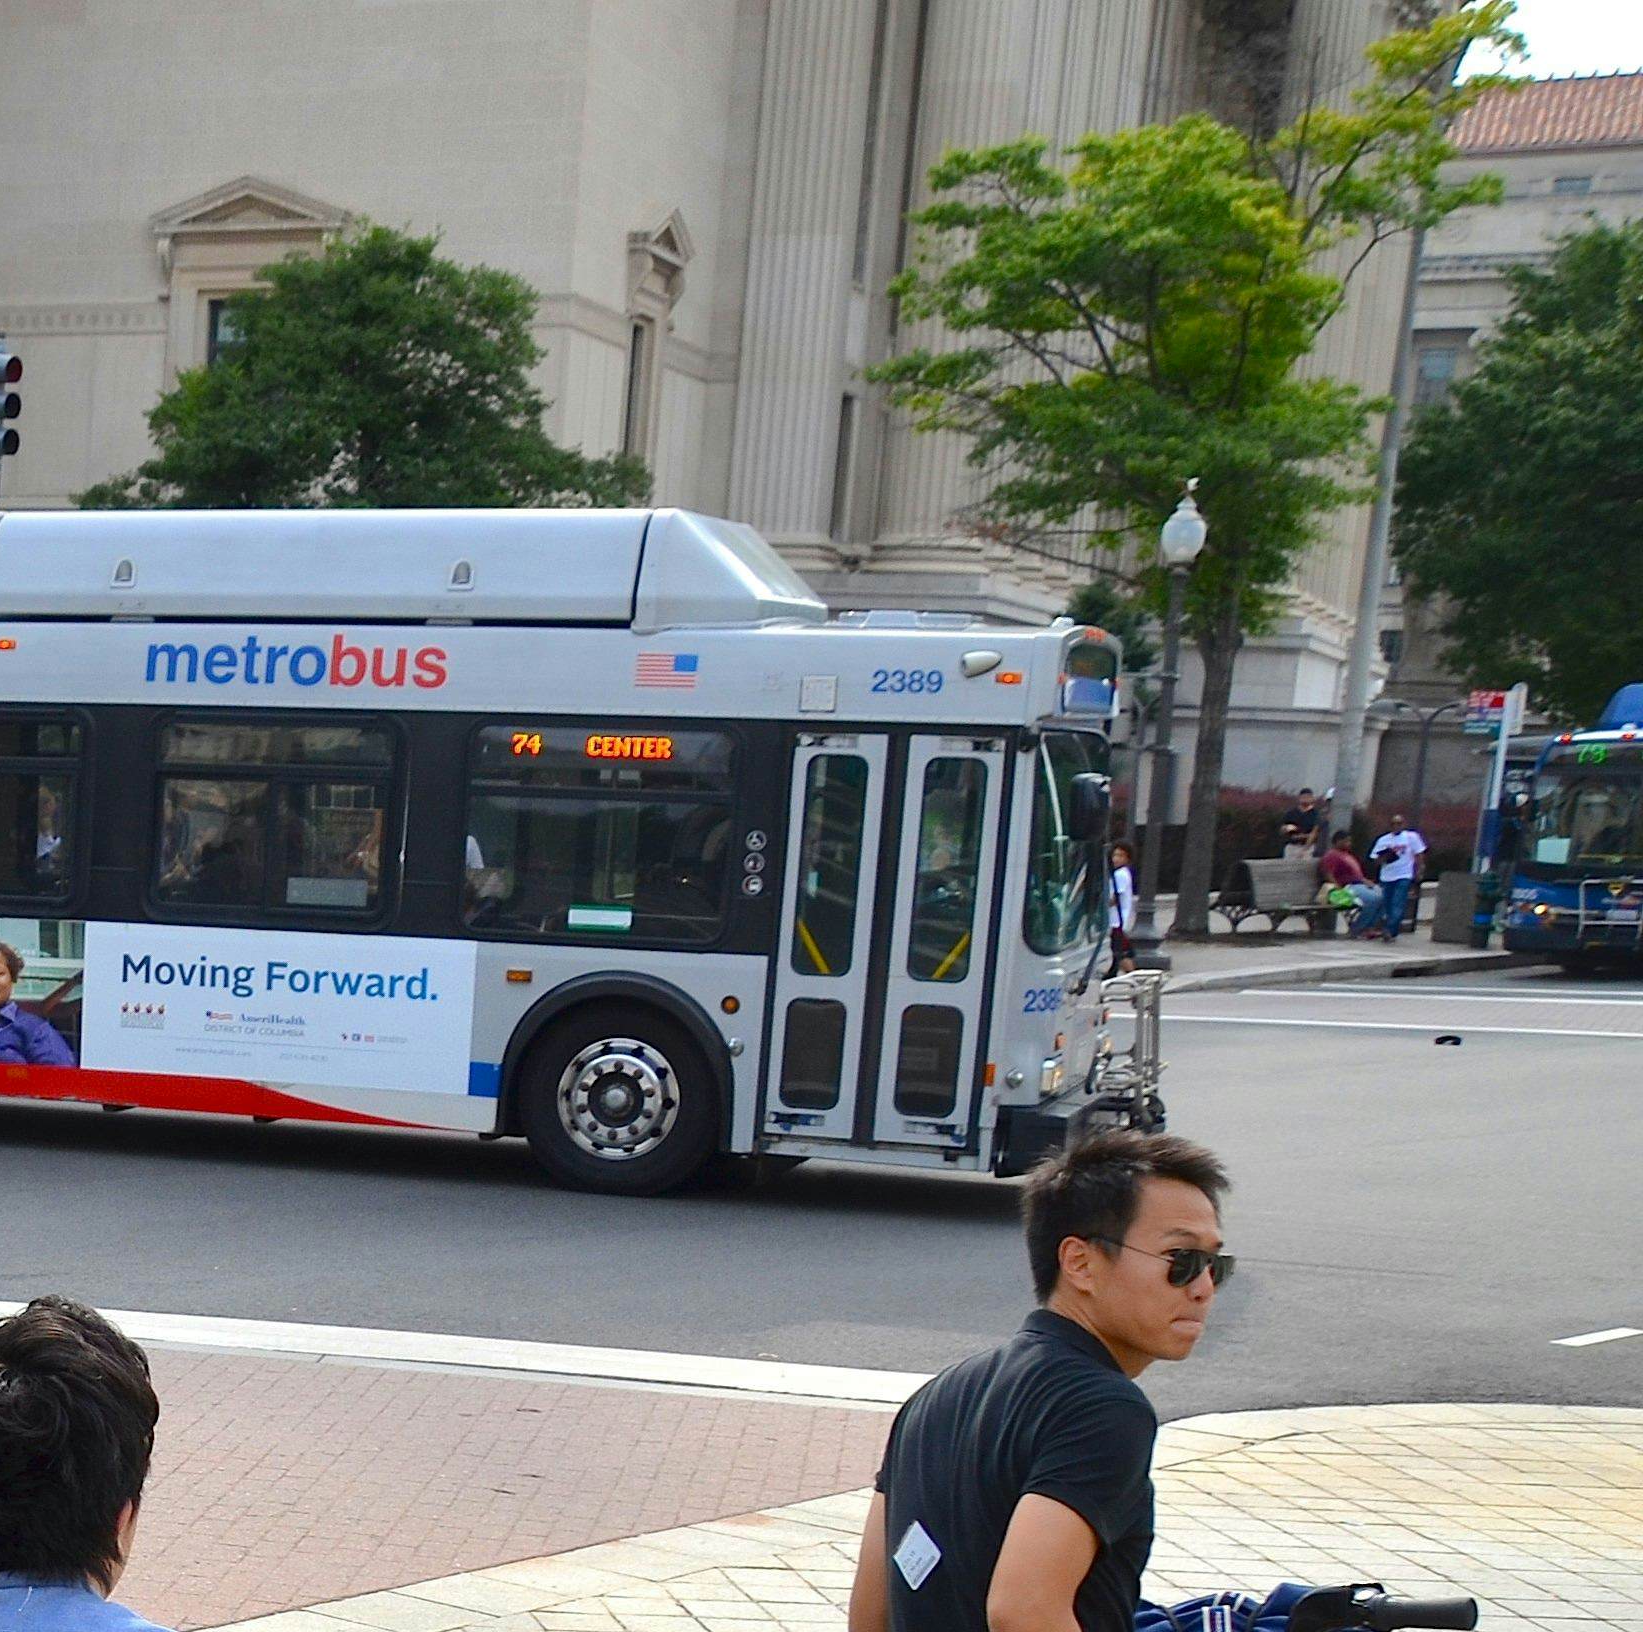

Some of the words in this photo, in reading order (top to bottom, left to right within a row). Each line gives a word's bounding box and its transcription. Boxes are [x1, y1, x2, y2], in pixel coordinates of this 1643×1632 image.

[145, 634, 447, 688] metrobus
[871, 669, 944, 693] 2389
[512, 733, 543, 756] 74
[586, 735, 673, 760] CENTER
[1578, 743, 1608, 764] 79
[121, 953, 256, 998] Moving
[265, 961, 439, 1001] Forward.
